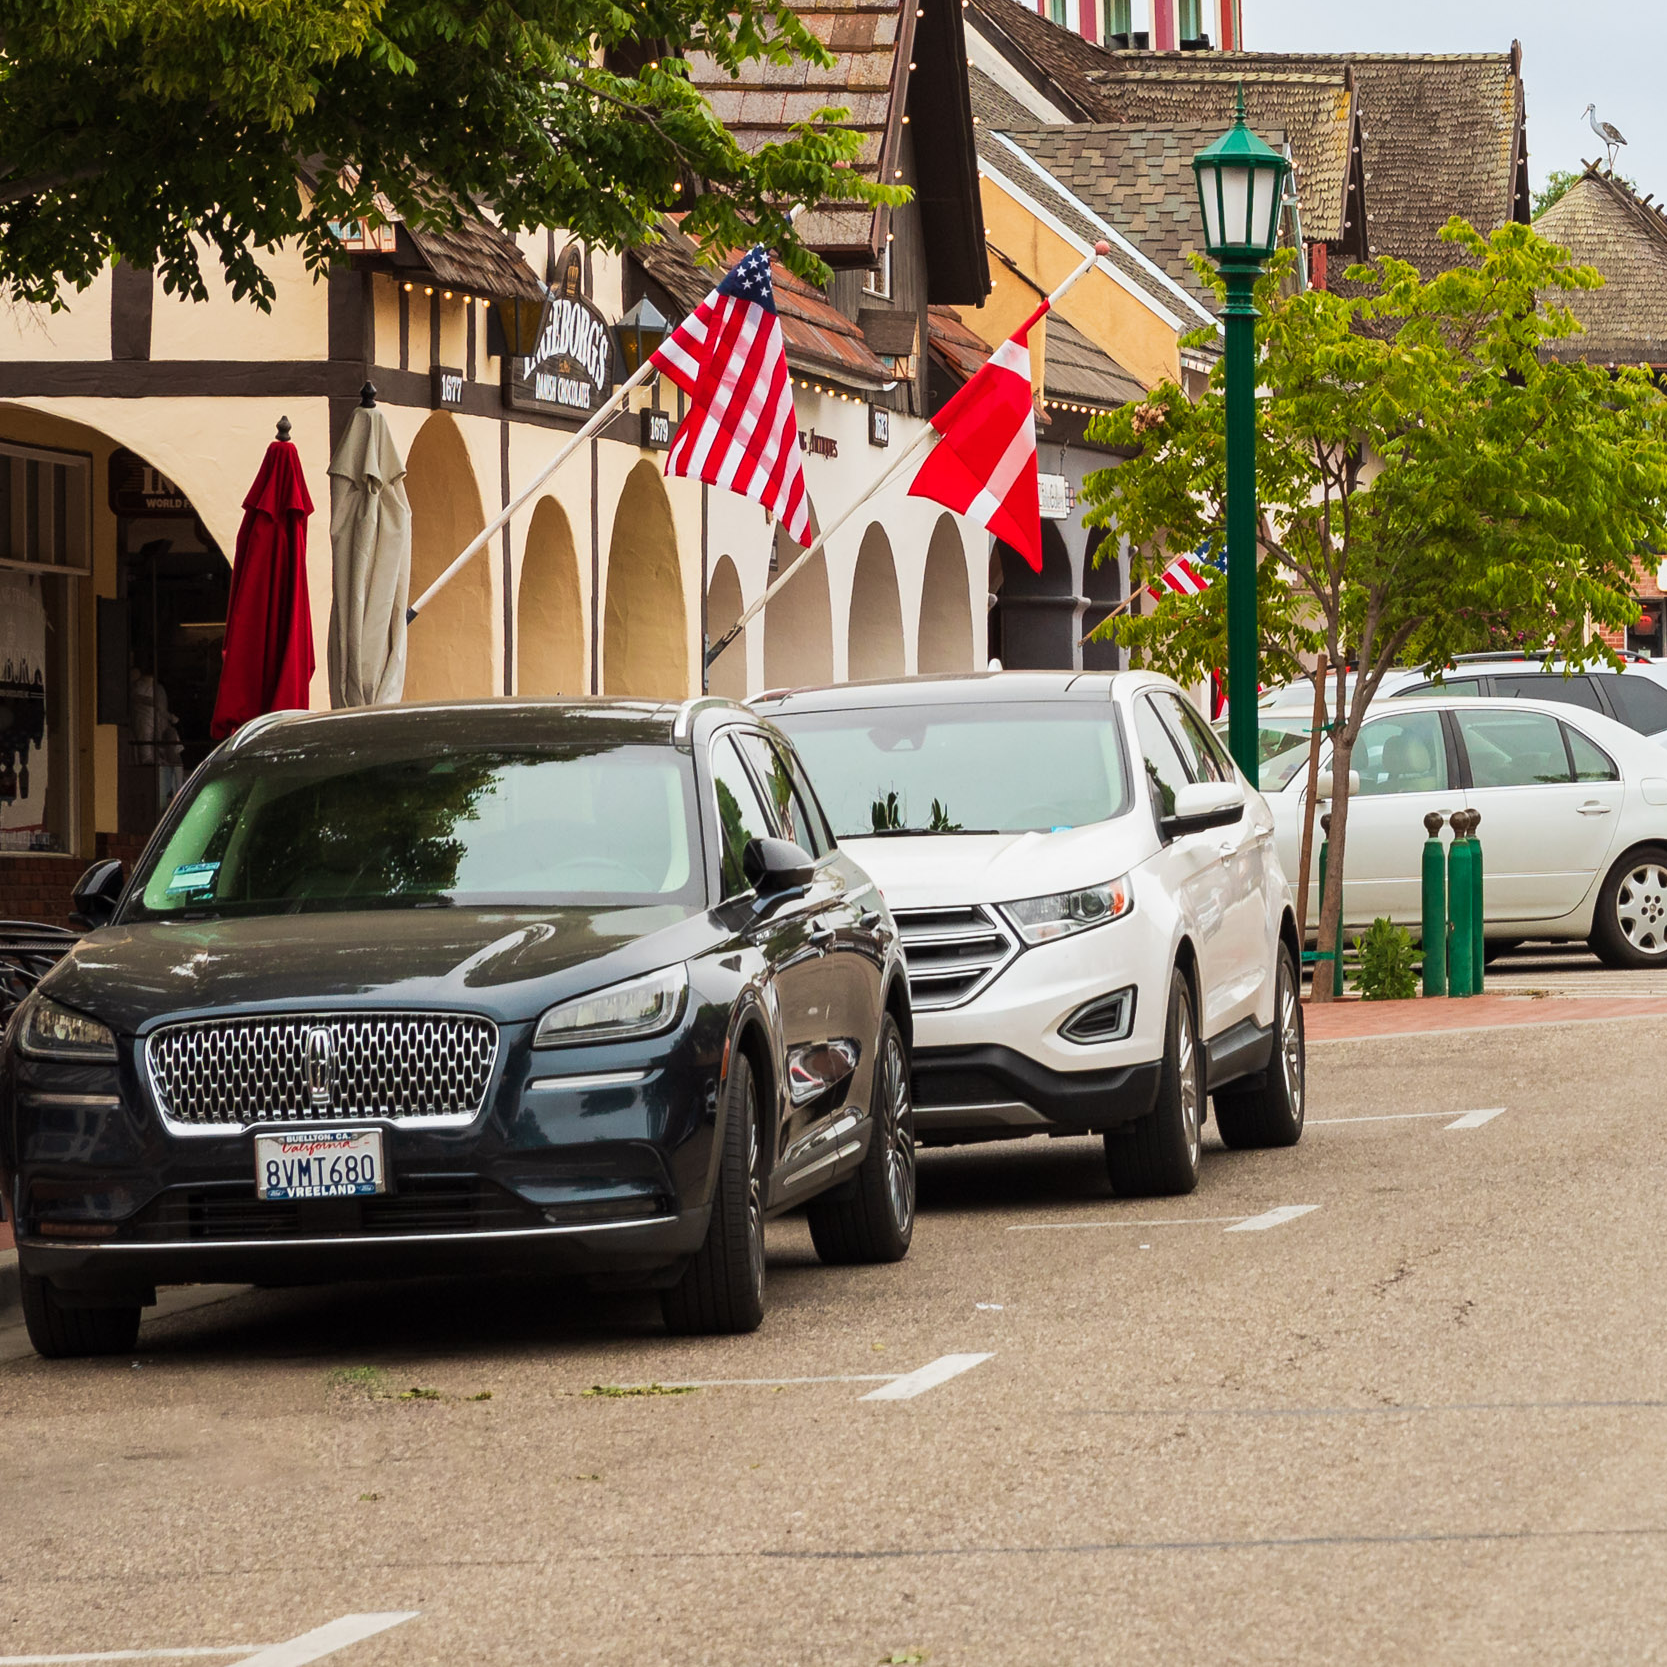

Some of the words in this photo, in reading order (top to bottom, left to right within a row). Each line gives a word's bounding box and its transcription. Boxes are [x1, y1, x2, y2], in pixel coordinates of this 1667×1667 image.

[442, 374, 463, 403] 1677
[535, 373, 557, 402] DANISH
[557, 378, 590, 410] CHOCOLATES
[650, 416, 669, 443] 1679
[146, 499, 182, 508] WORLD
[266, 1154, 375, 1188] 8VMT680
[286, 1183, 356, 1198] VREELAND
